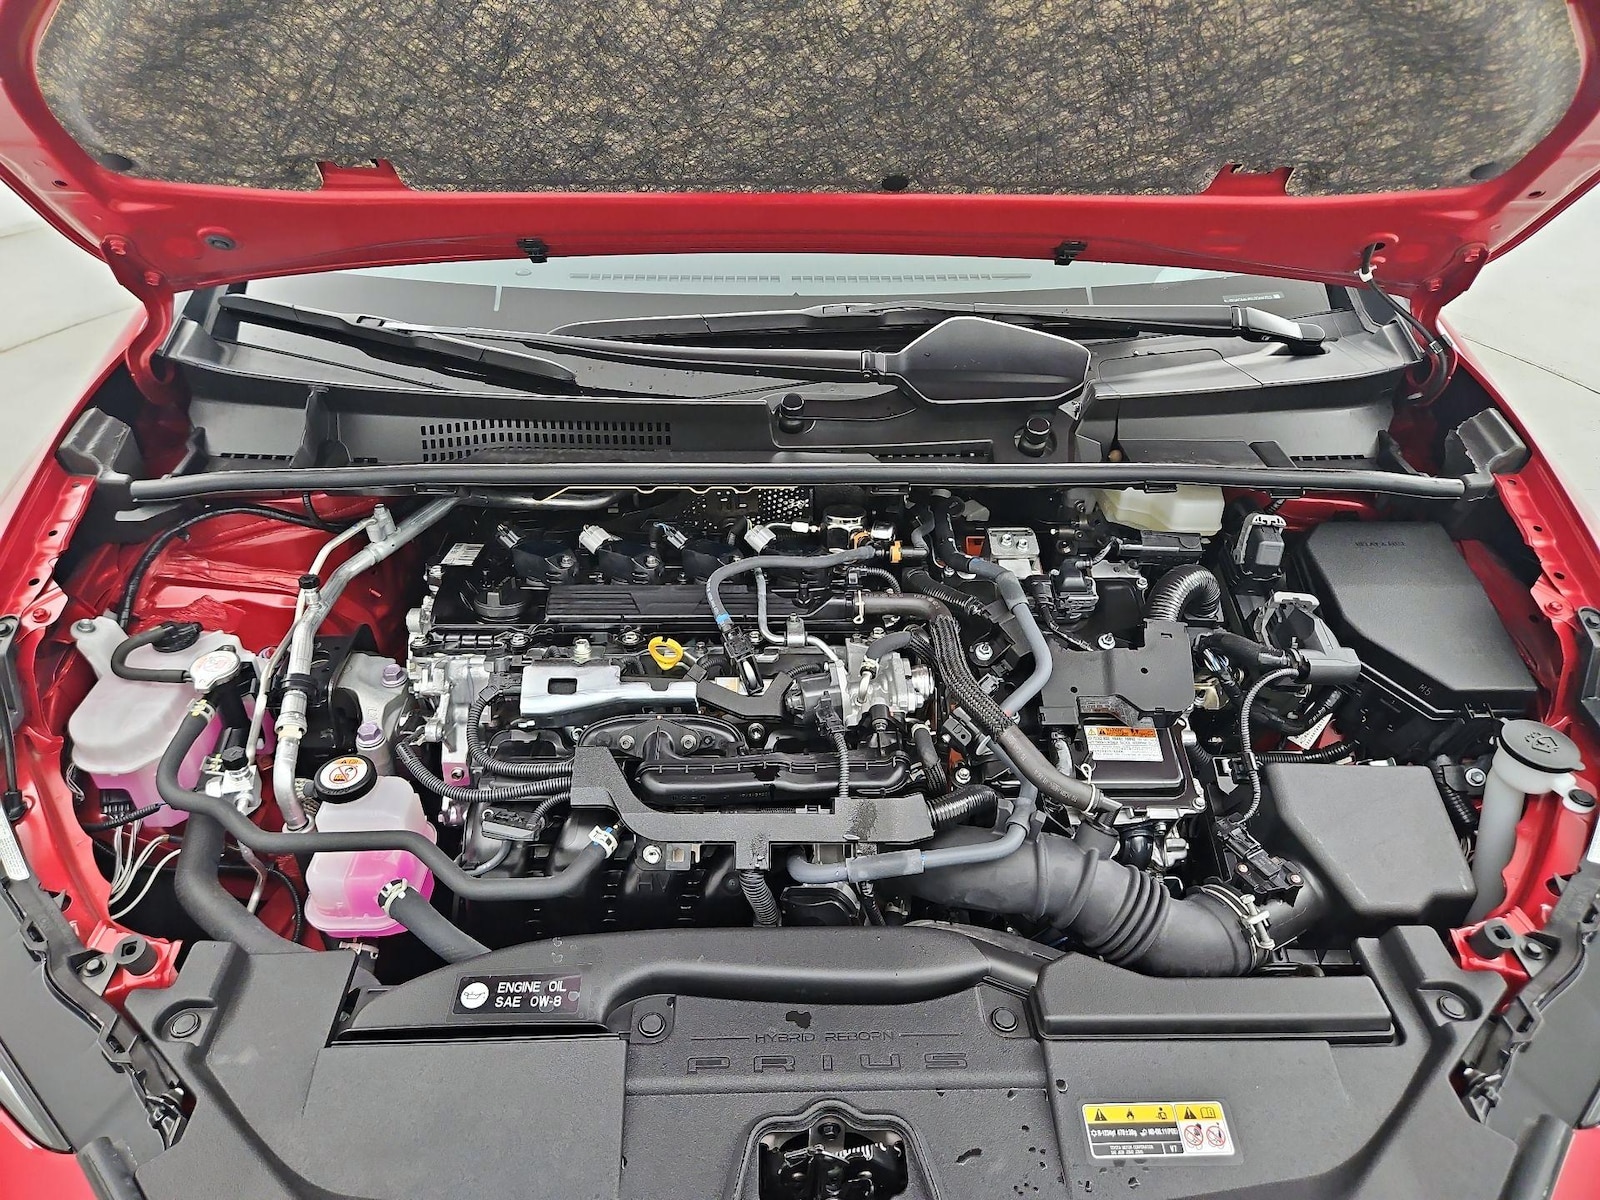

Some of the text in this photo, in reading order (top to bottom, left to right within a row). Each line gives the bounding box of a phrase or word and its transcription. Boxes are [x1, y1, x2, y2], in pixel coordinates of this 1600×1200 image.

[497, 980, 567, 993] ENGINE OIL
[495, 996, 562, 1007] SAE 0W-8
[755, 1031, 894, 1043] HYBRID REBORN
[687, 1053, 968, 1075] PRIUS
